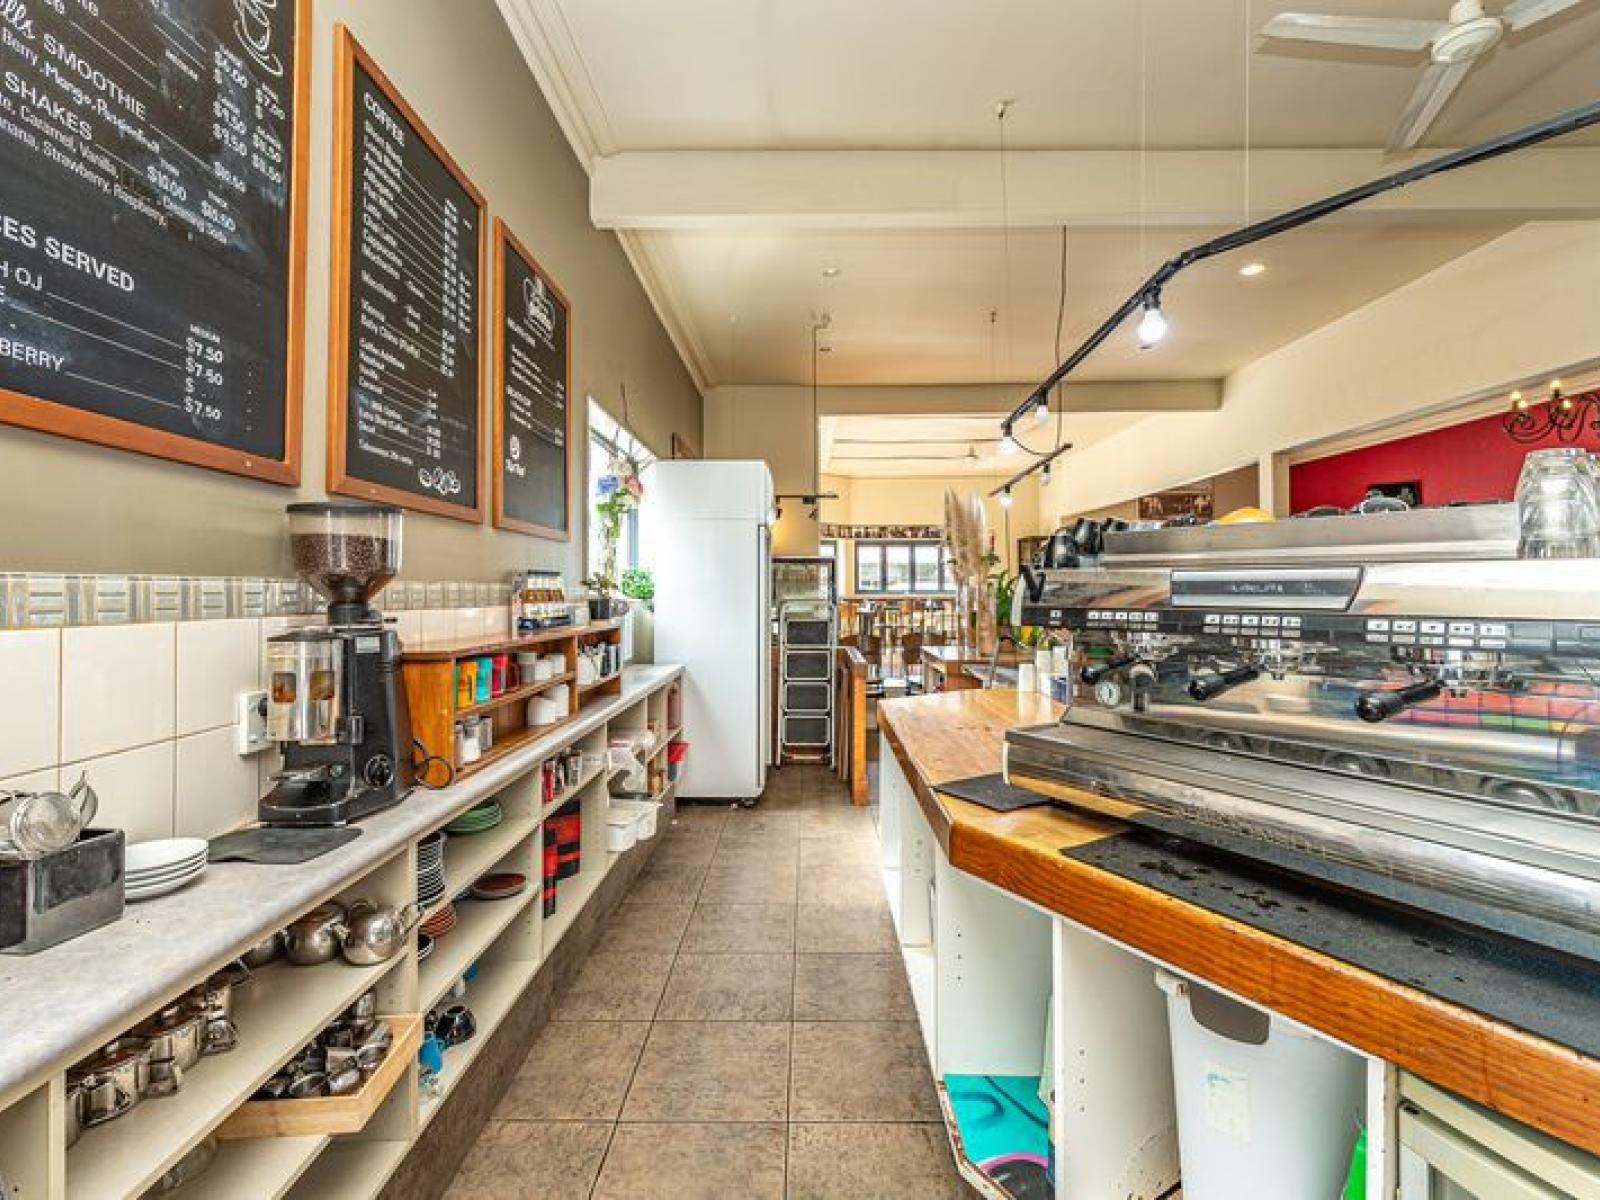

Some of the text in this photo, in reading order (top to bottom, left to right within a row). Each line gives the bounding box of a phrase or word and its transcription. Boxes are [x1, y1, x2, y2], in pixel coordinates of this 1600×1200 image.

[5, 71, 92, 140] SHAKES
[43, 32, 147, 121] SMOOTHIE
[0, 215, 136, 292] ES SERVED
[15, 267, 43, 292] OJ
[0, 336, 64, 373] BERRY
